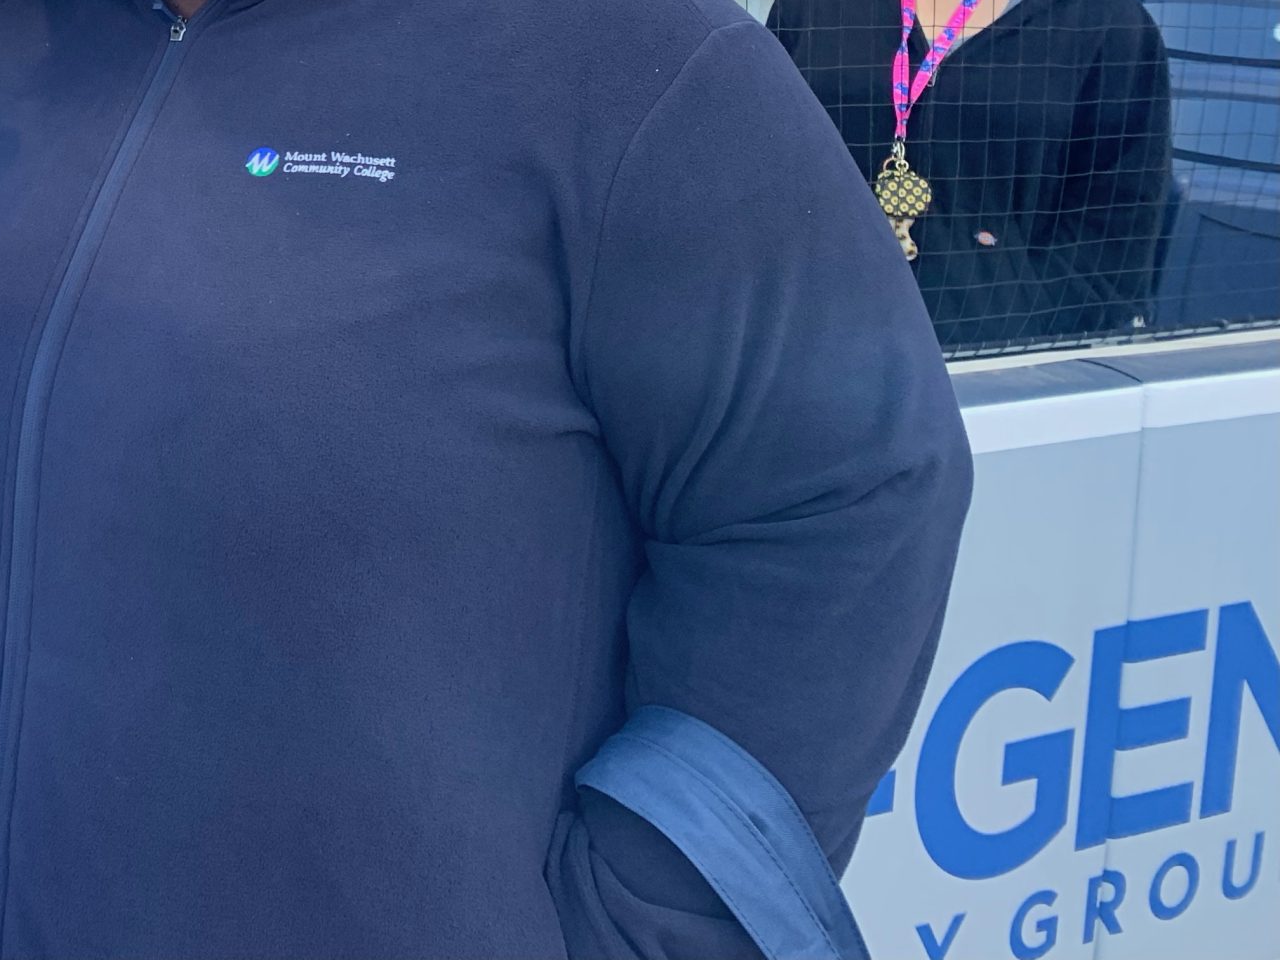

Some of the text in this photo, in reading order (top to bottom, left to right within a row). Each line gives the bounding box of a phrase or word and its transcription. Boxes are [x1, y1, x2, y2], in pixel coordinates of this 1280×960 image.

[284, 151, 397, 168] Mount Wachusett
[282, 162, 396, 183] Community College
